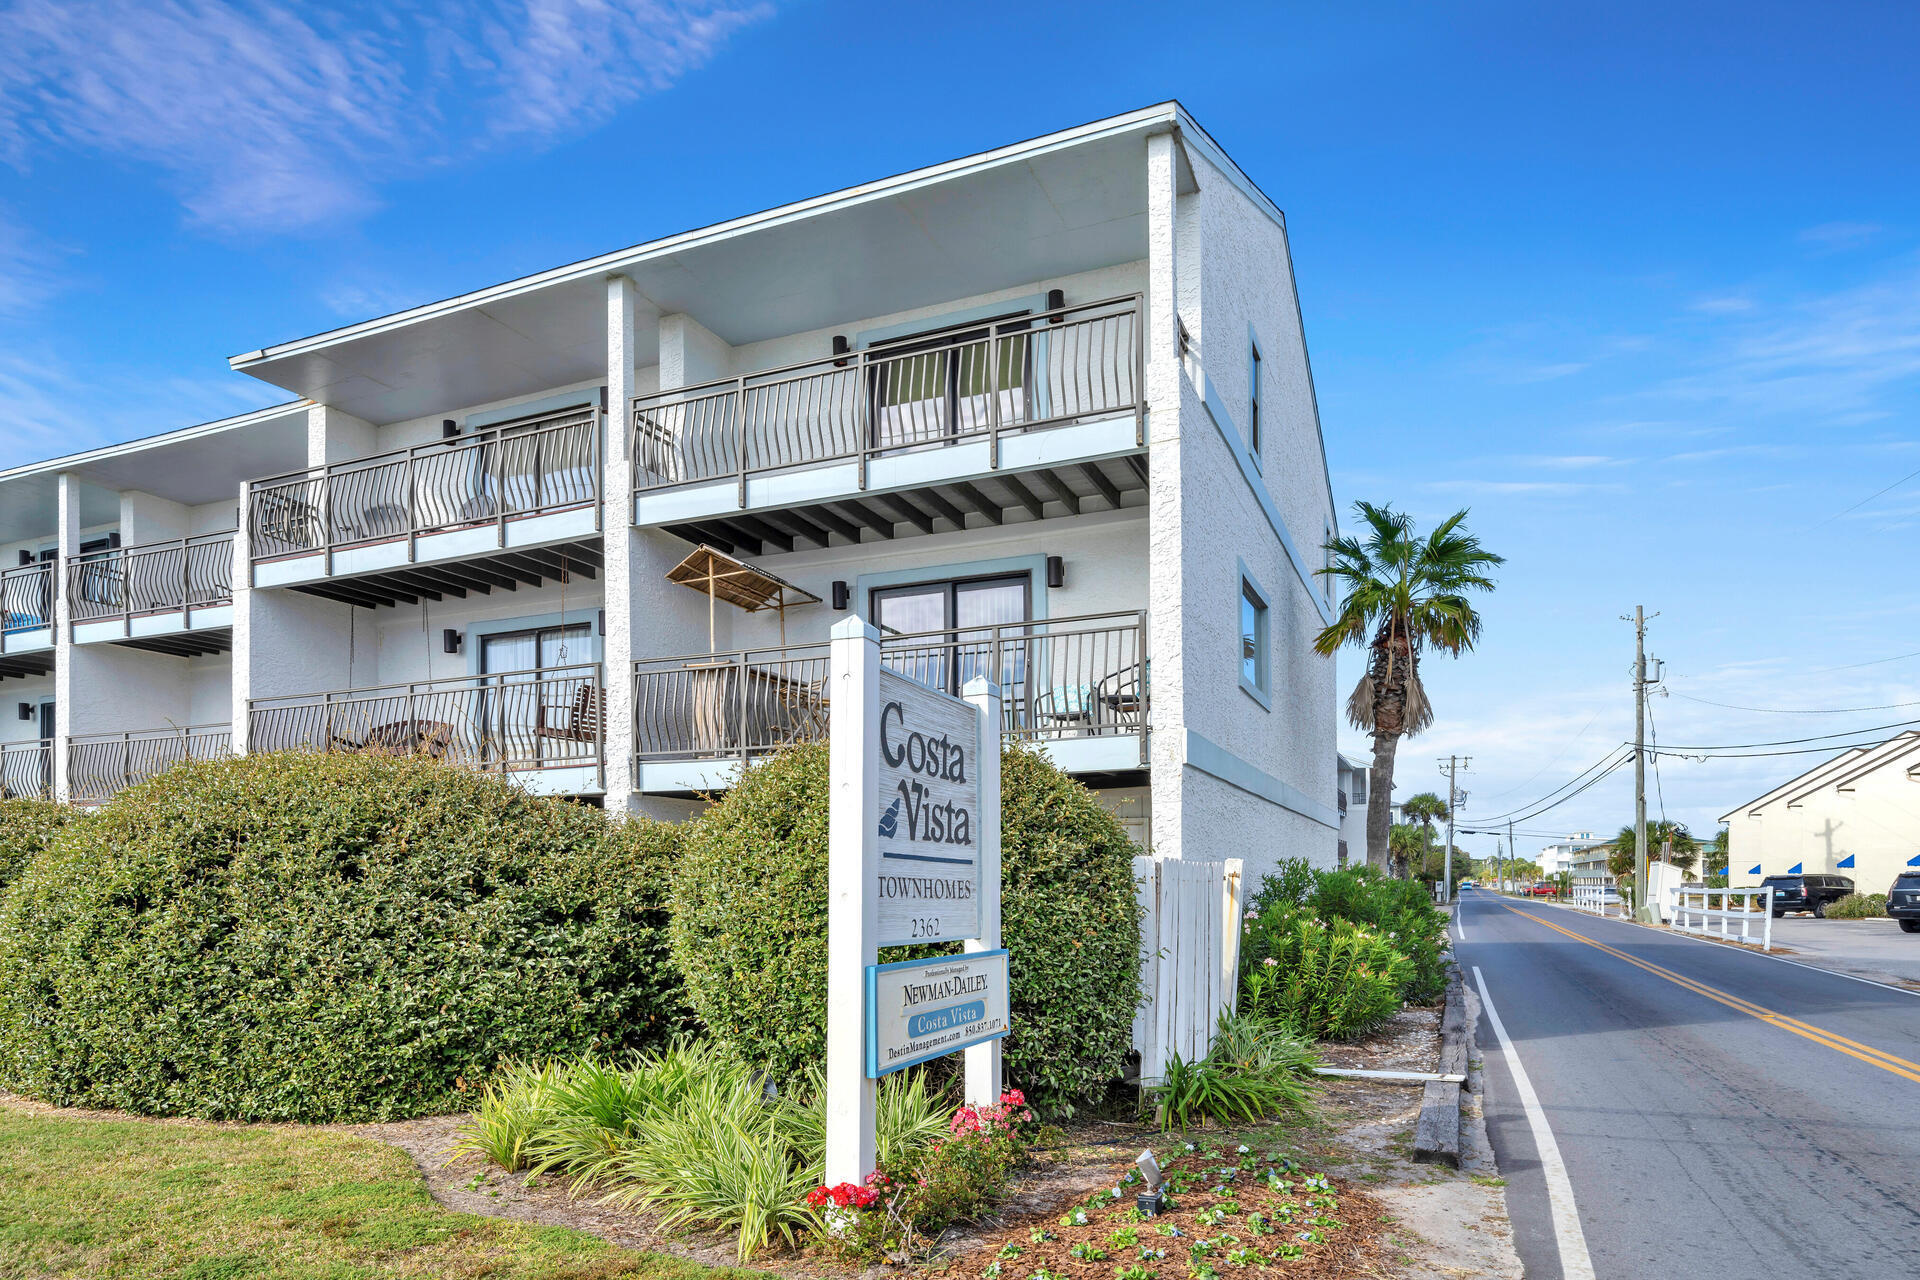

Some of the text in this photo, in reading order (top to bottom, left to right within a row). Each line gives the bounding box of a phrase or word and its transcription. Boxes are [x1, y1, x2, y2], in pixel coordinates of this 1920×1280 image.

[880, 701, 967, 784] Costa
[898, 777, 972, 846] Vista
[878, 876, 971, 899] TOWNHOMES
[911, 918, 940, 938] 2362
[917, 1006, 977, 1034] Costa Vista
[888, 1018, 1002, 1060] DestinManagement.com 850.837.1071
